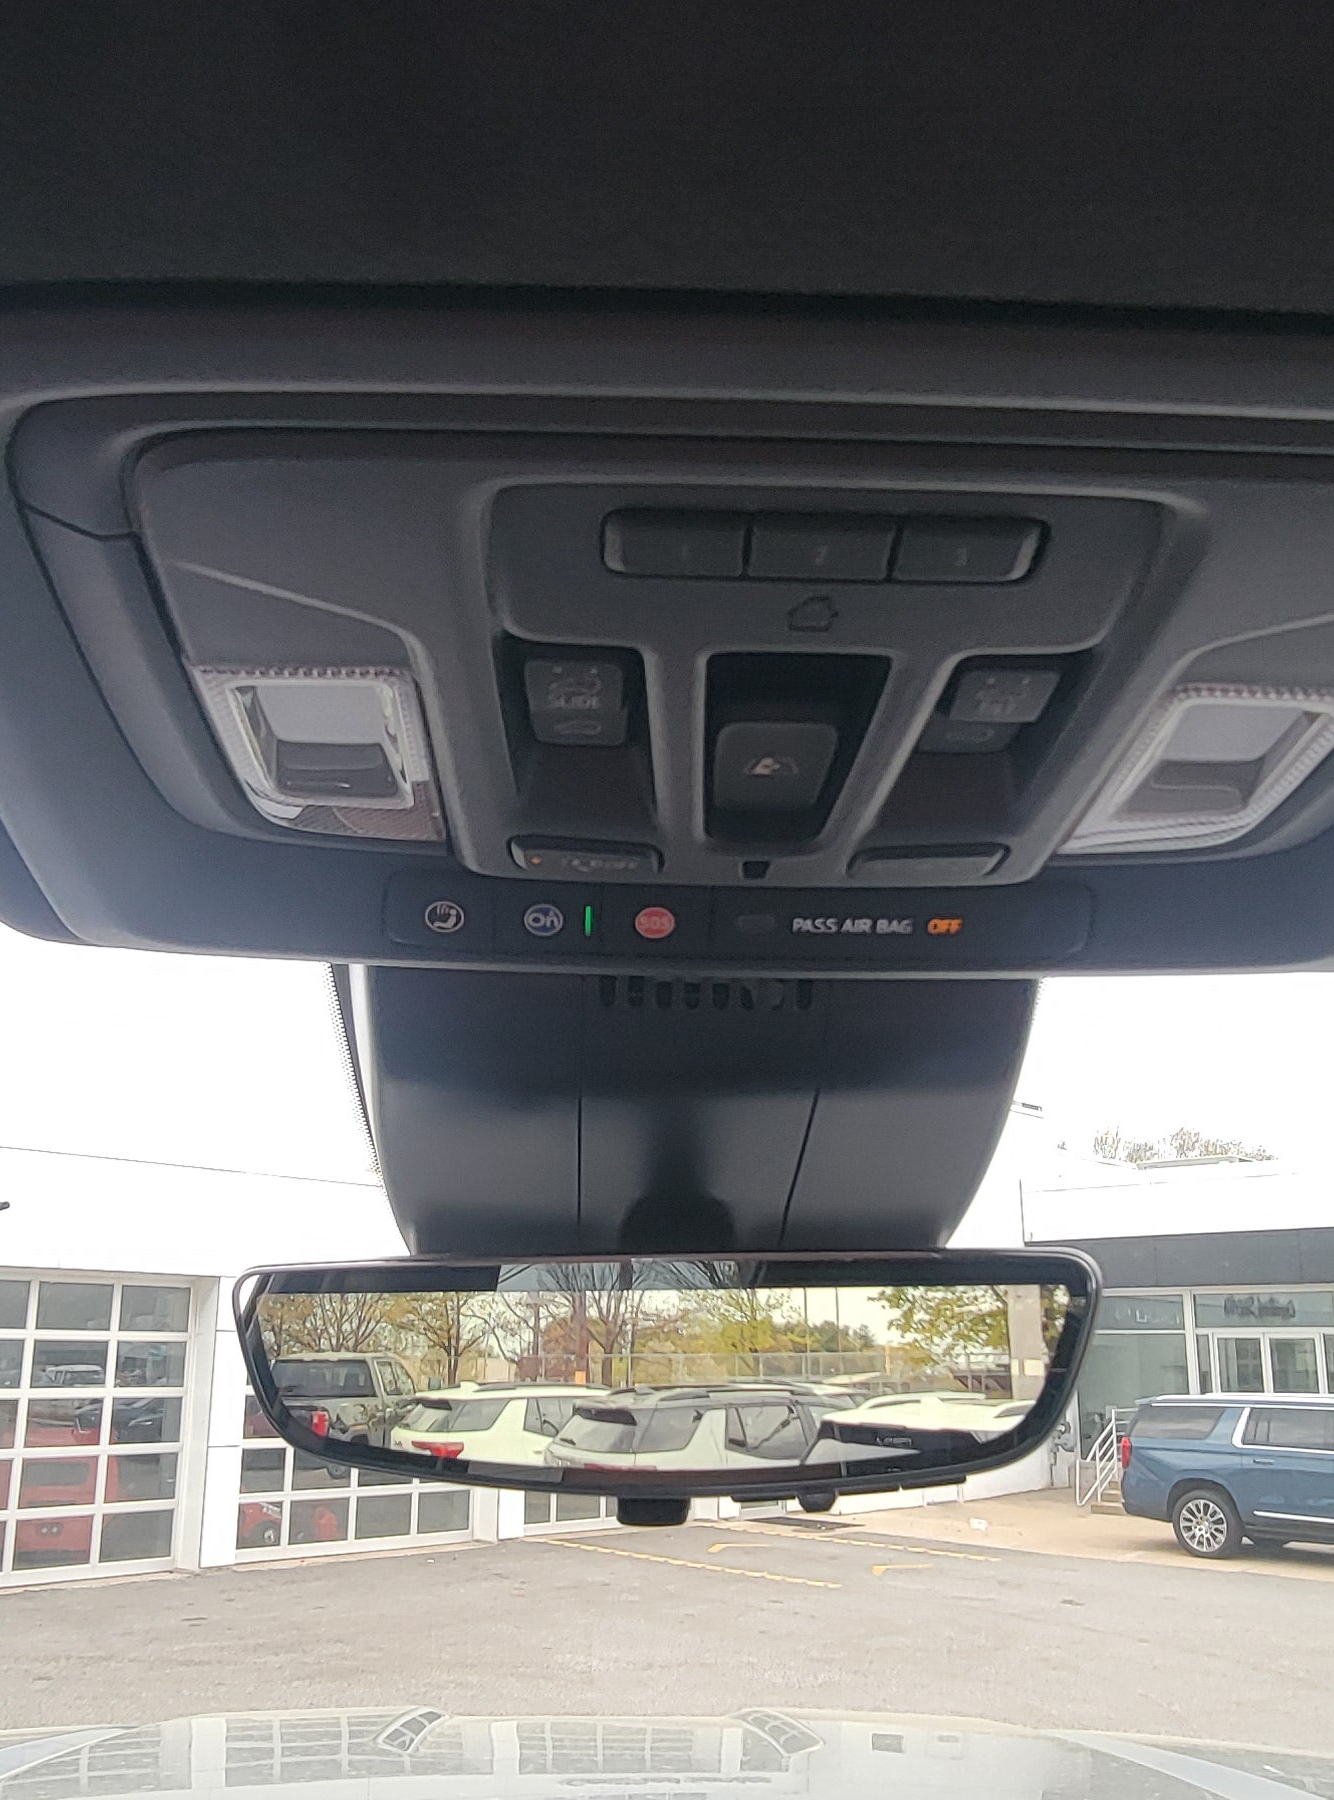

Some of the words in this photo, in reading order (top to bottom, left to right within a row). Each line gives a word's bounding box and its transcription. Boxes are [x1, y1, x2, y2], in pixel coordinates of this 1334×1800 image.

[638, 915, 672, 930] SOS
[792, 917, 839, 934] PASS
[841, 918, 873, 934] AIR
[875, 918, 915, 935] BAG
[926, 918, 964, 936] OFF
